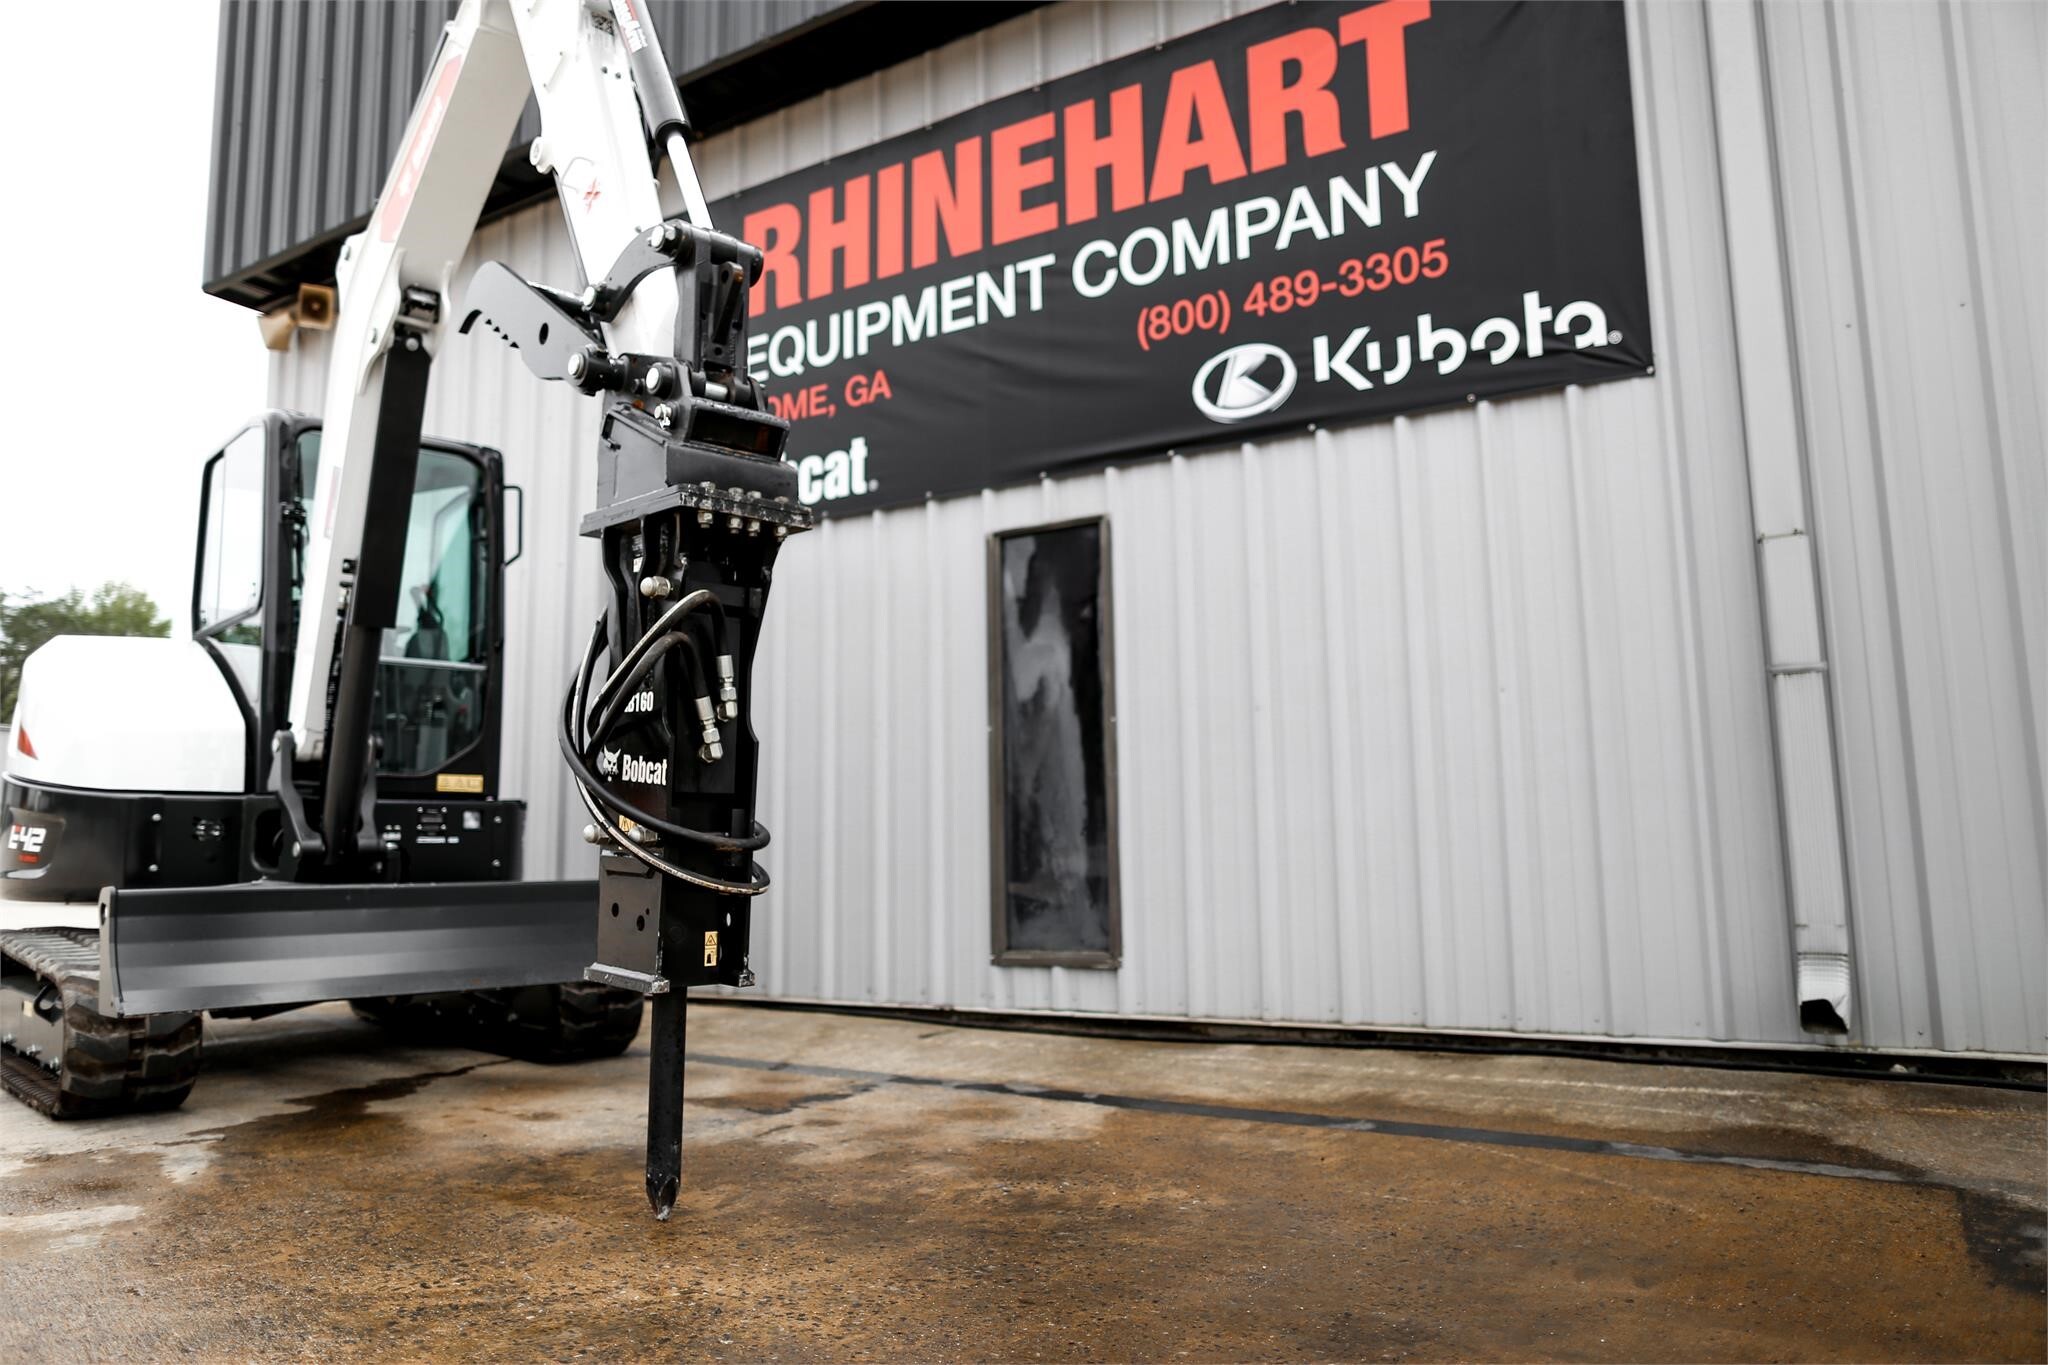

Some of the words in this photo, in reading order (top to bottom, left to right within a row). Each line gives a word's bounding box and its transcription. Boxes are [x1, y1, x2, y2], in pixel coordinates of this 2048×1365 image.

[743, 0, 1432, 317] RHINEHART
[746, 253, 1056, 384] EQUIPMENT
[1072, 150, 1438, 298] COMPANY
[1137, 289, 1231, 351] (800)
[1243, 238, 1449, 317] 489-3305
[1313, 290, 1608, 391] Kubota
[767, 383, 837, 421] OME,
[844, 369, 892, 408] GA
[781, 436, 868, 505] cat
[624, 691, 654, 712] B160
[622, 754, 667, 786] Bobcat
